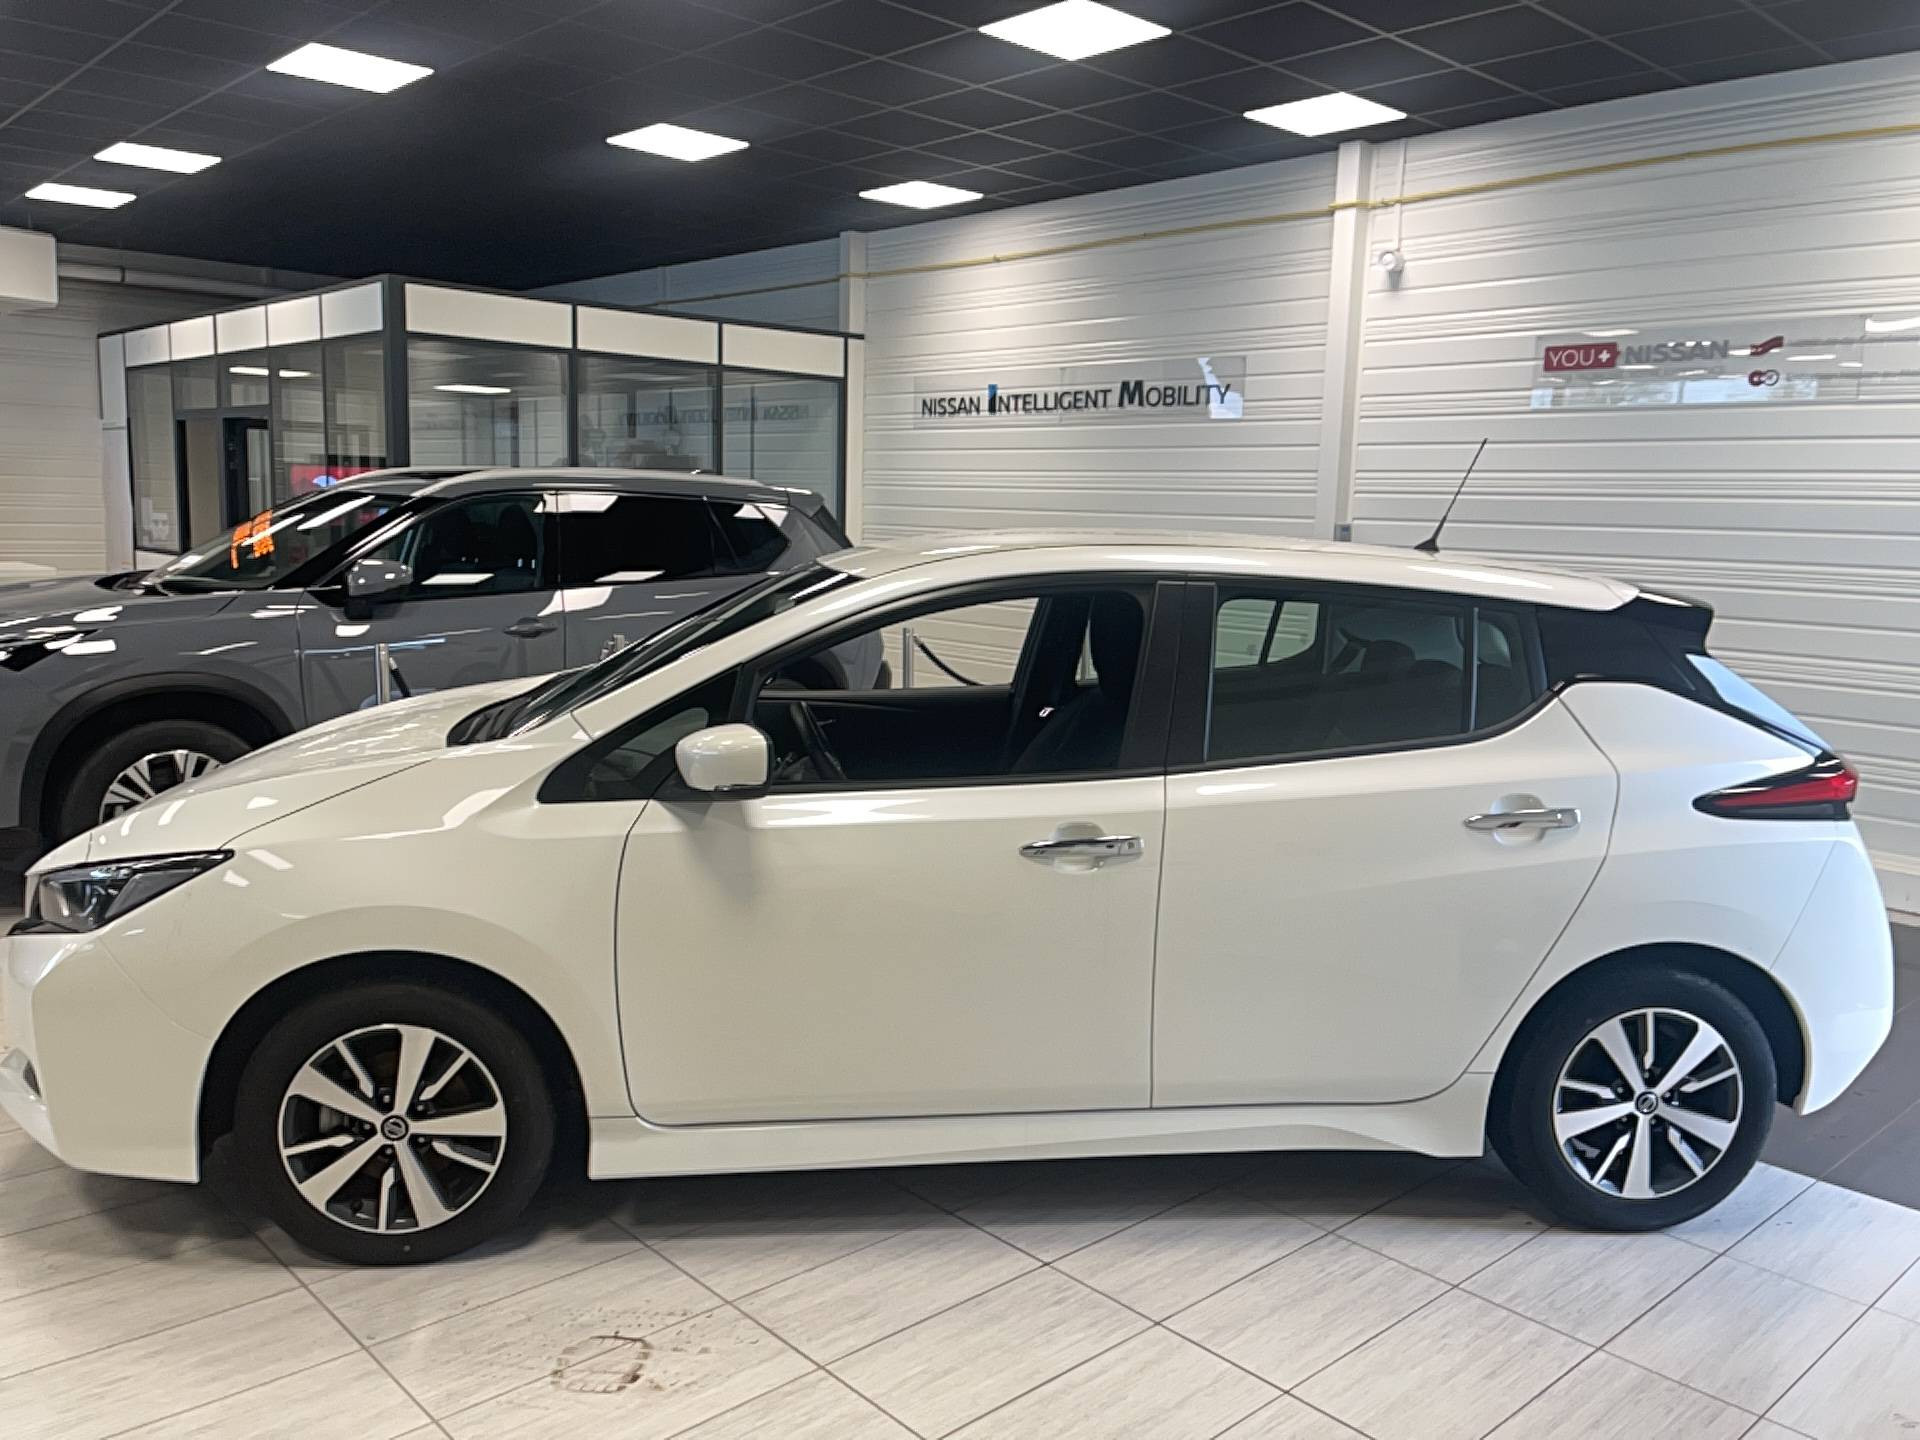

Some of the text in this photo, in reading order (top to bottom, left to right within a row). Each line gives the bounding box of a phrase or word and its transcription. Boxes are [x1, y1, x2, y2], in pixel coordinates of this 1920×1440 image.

[1625, 340, 1729, 364] NISSAN
[921, 379, 1231, 417] NISSAN INTELLIGENT MOBILITY
